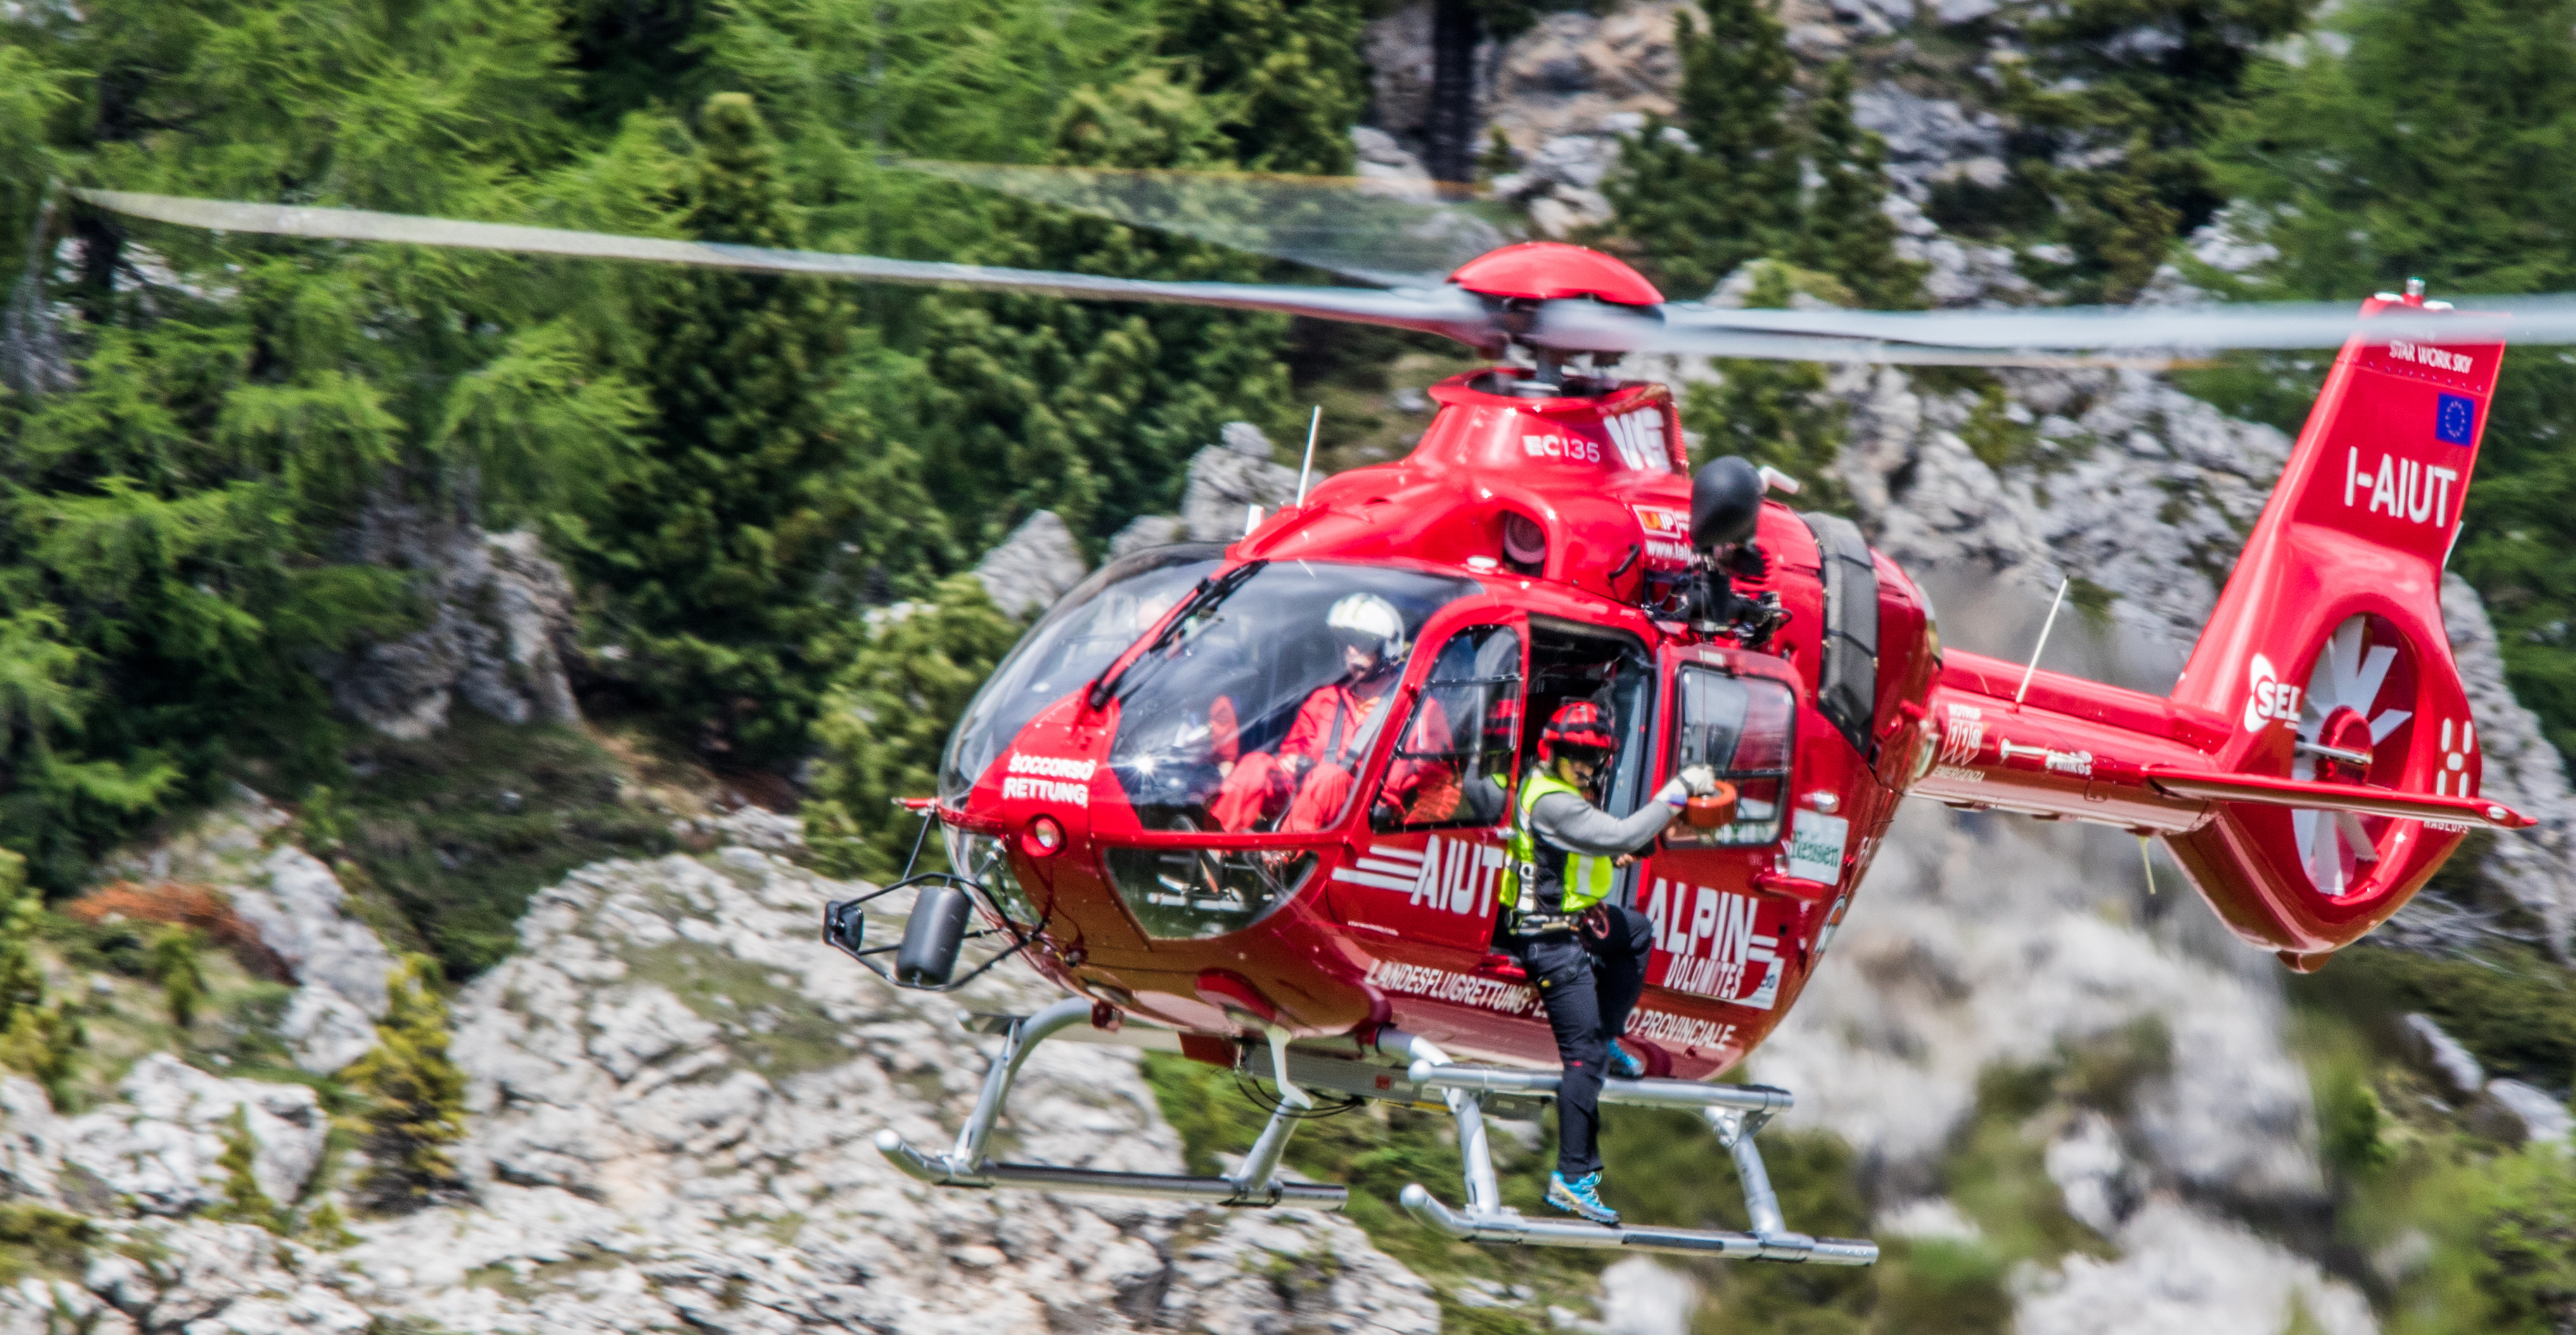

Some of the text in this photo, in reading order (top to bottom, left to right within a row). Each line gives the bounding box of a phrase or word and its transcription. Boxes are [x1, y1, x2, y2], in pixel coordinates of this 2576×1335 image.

[2389, 340, 2415, 362] STAR
[2418, 344, 2452, 370] WORK
[1523, 435, 1601, 463] EC135
[2345, 446, 2457, 527] I-AIUT
[2258, 681, 2301, 722] SEL
[1951, 725, 1981, 749] 118
[1009, 754, 1096, 780] SOCCORSO
[1004, 778, 1089, 806] RETTUNG
[1410, 834, 1505, 918] AIUT
[1647, 877, 1758, 966] ALPIN
[1364, 958, 1531, 1012] LANDESFLUGRETTUNG
[1663, 954, 1745, 1000] DOLOMITES
[1637, 1010, 1736, 1051] PROVINCIALE
